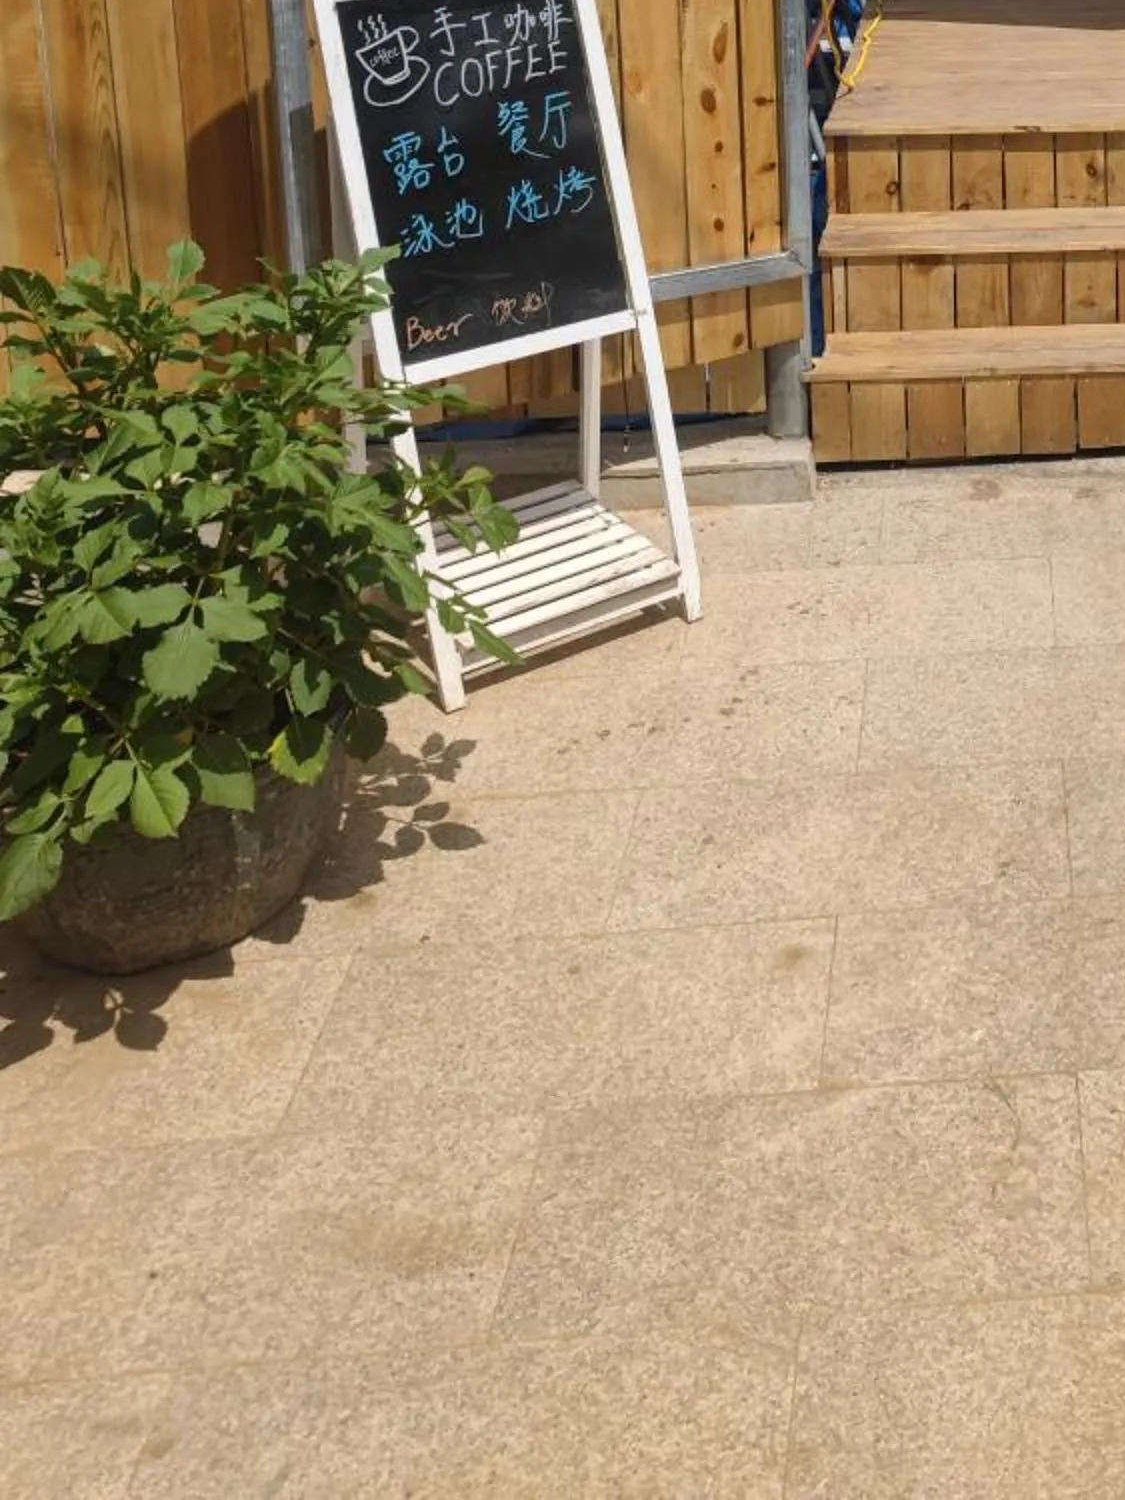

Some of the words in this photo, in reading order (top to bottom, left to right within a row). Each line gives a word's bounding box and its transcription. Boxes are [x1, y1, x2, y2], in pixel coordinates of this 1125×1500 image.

[434, 40, 568, 106] COFFEE
[383, 125, 465, 196] 露台
[498, 90, 572, 159] 餐厅
[400, 197, 484, 259] 泳池
[506, 165, 598, 230] 烧烤
[405, 313, 473, 351] Beer
